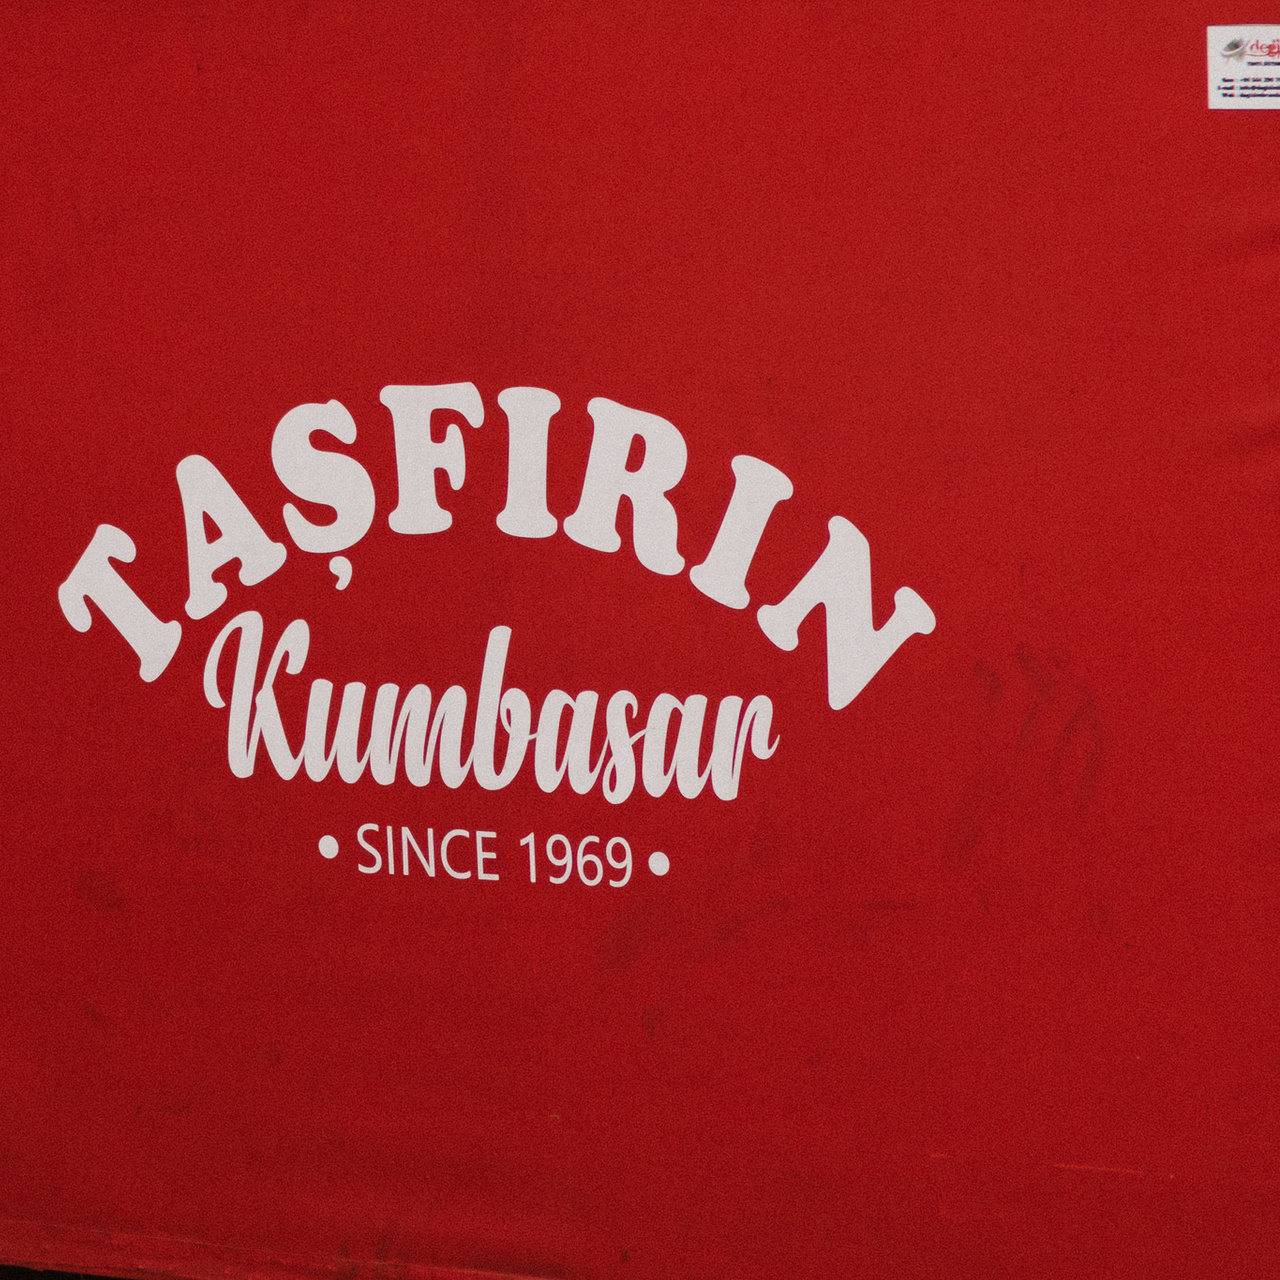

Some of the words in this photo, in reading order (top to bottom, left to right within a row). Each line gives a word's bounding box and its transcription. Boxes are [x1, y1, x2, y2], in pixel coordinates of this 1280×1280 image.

[58, 382, 937, 711] TAŞFIRIN
[204, 610, 781, 805] Kumbasar
[356, 822, 500, 881] SINCE
[519, 832, 633, 888] 1969
